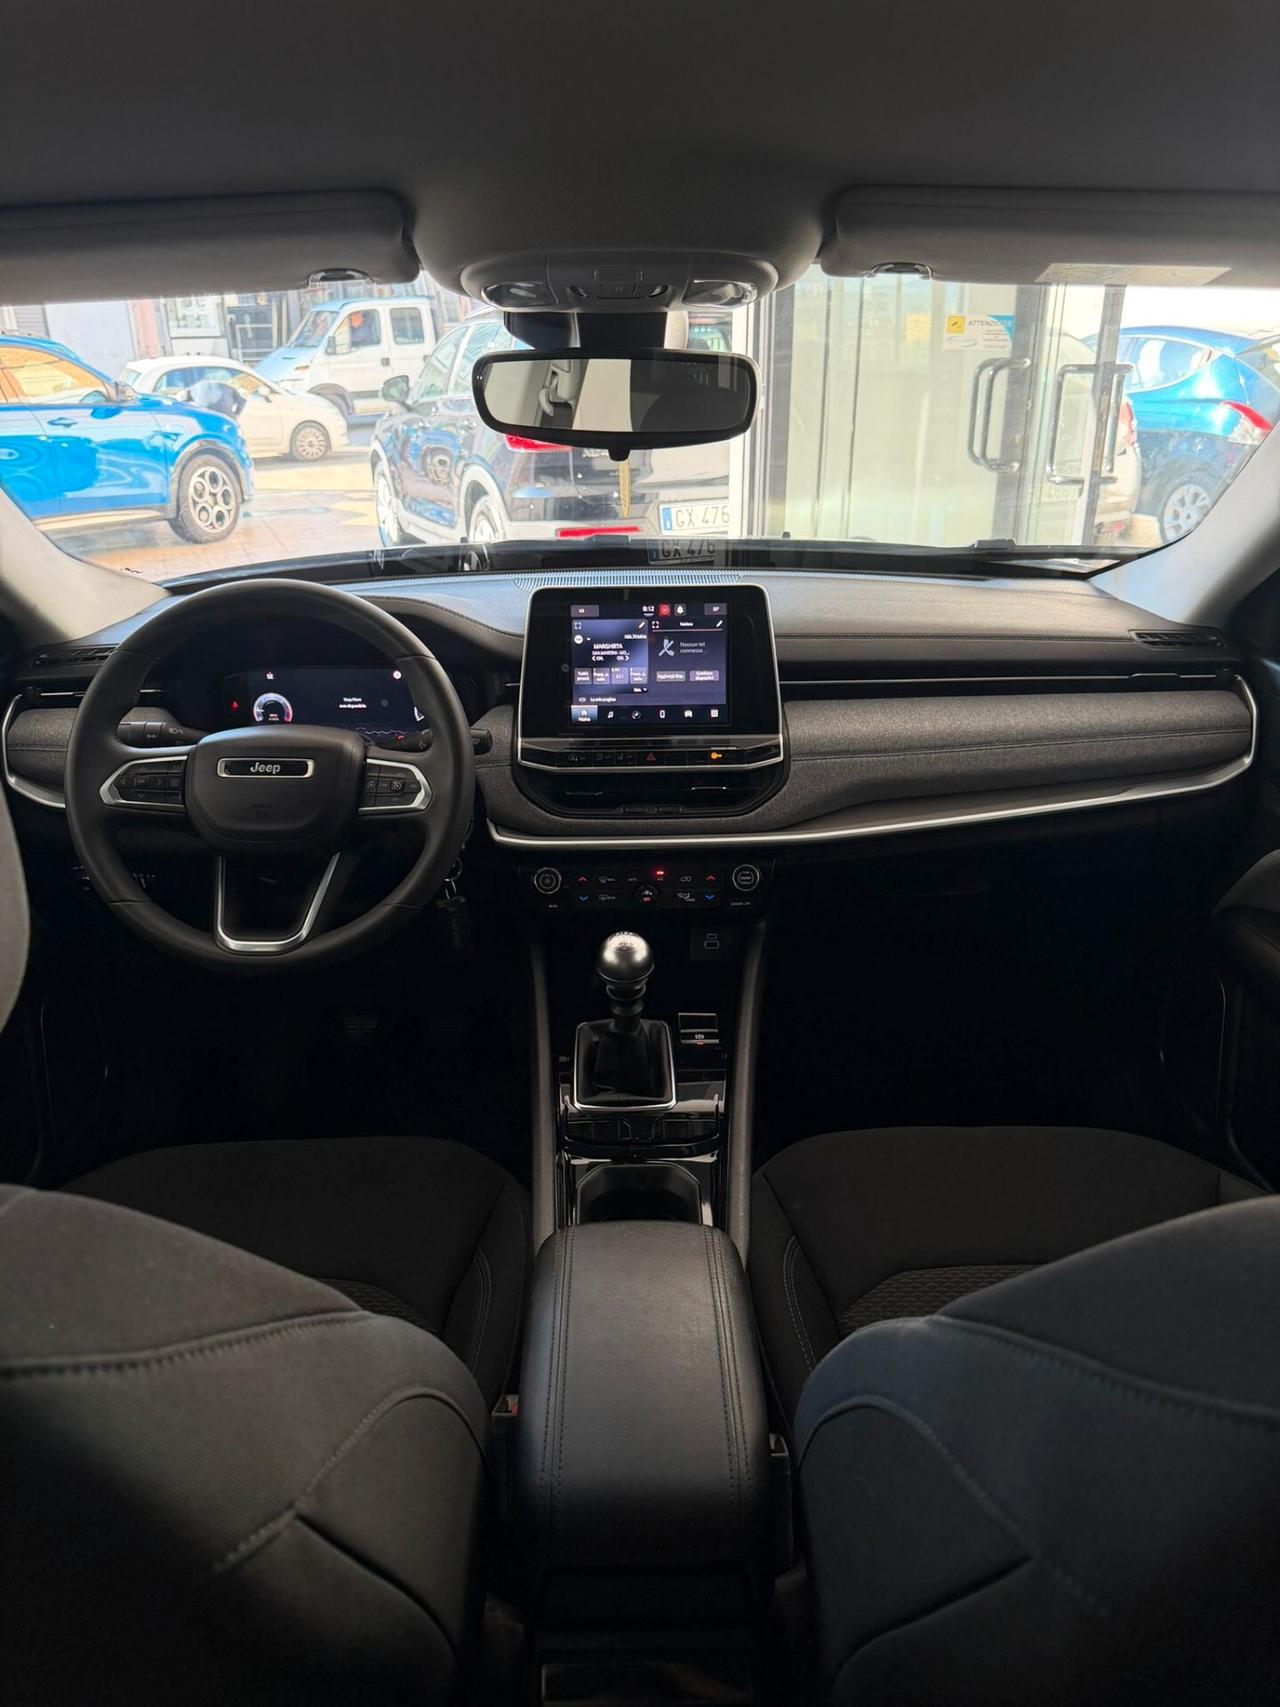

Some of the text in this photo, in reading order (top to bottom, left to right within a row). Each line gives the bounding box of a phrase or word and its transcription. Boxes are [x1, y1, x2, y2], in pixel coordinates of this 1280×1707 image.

[675, 505, 730, 528] GX 476
[250, 762, 281, 774] Jeep
